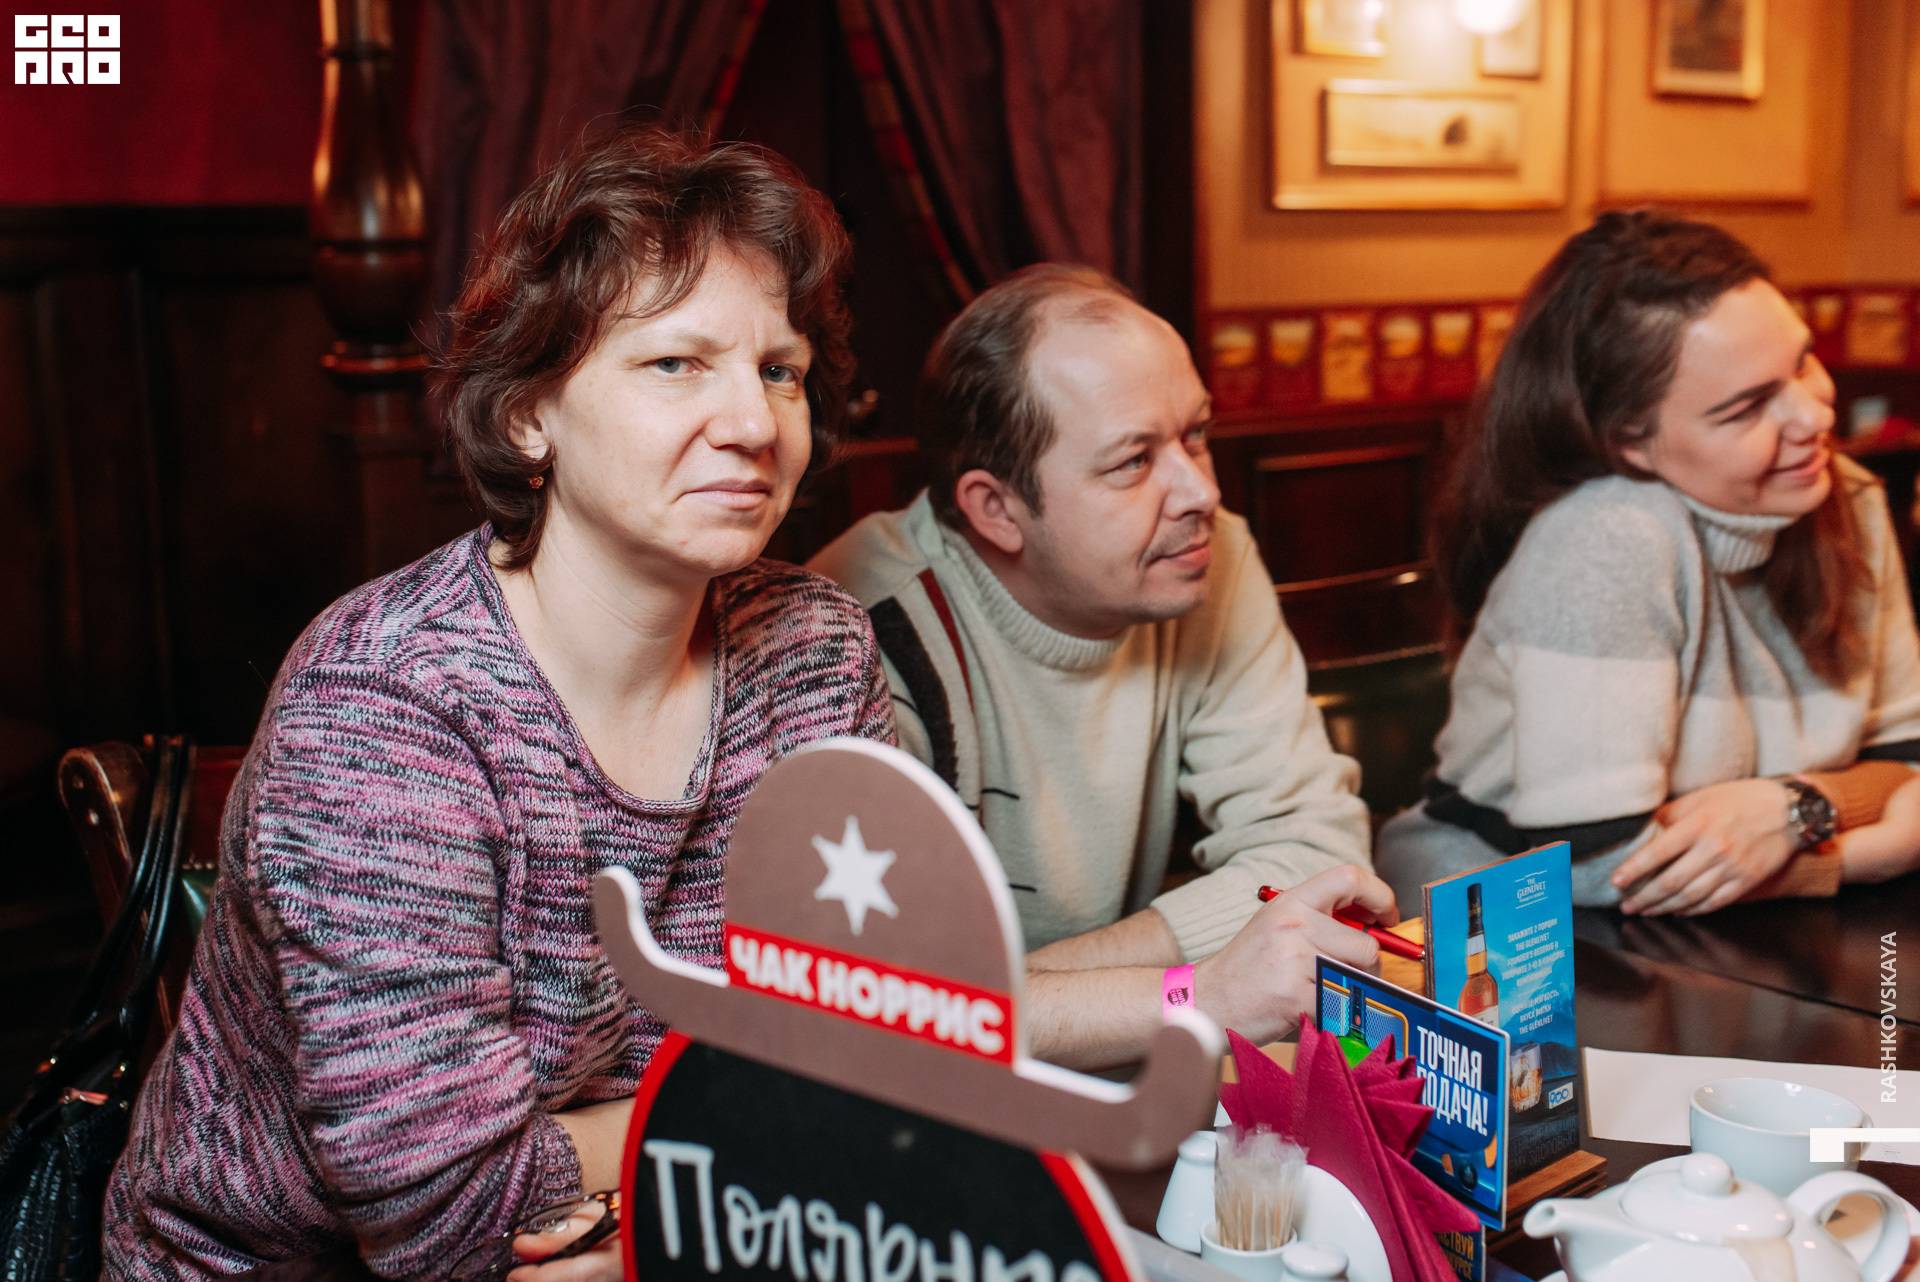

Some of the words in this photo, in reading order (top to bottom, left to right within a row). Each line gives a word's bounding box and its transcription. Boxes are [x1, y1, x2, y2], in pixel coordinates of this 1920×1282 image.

[1515, 941, 1525, 952] THE
[1525, 932, 1550, 948] GLENLIVET
[729, 934, 816, 1001] ЧАК
[816, 957, 1006, 1055] НОРРИС
[1518, 1024, 1529, 1034] THE
[1528, 1014, 1553, 1031] GLENLIVET
[1416, 1025, 1483, 1092] ТОЧНАЯ
